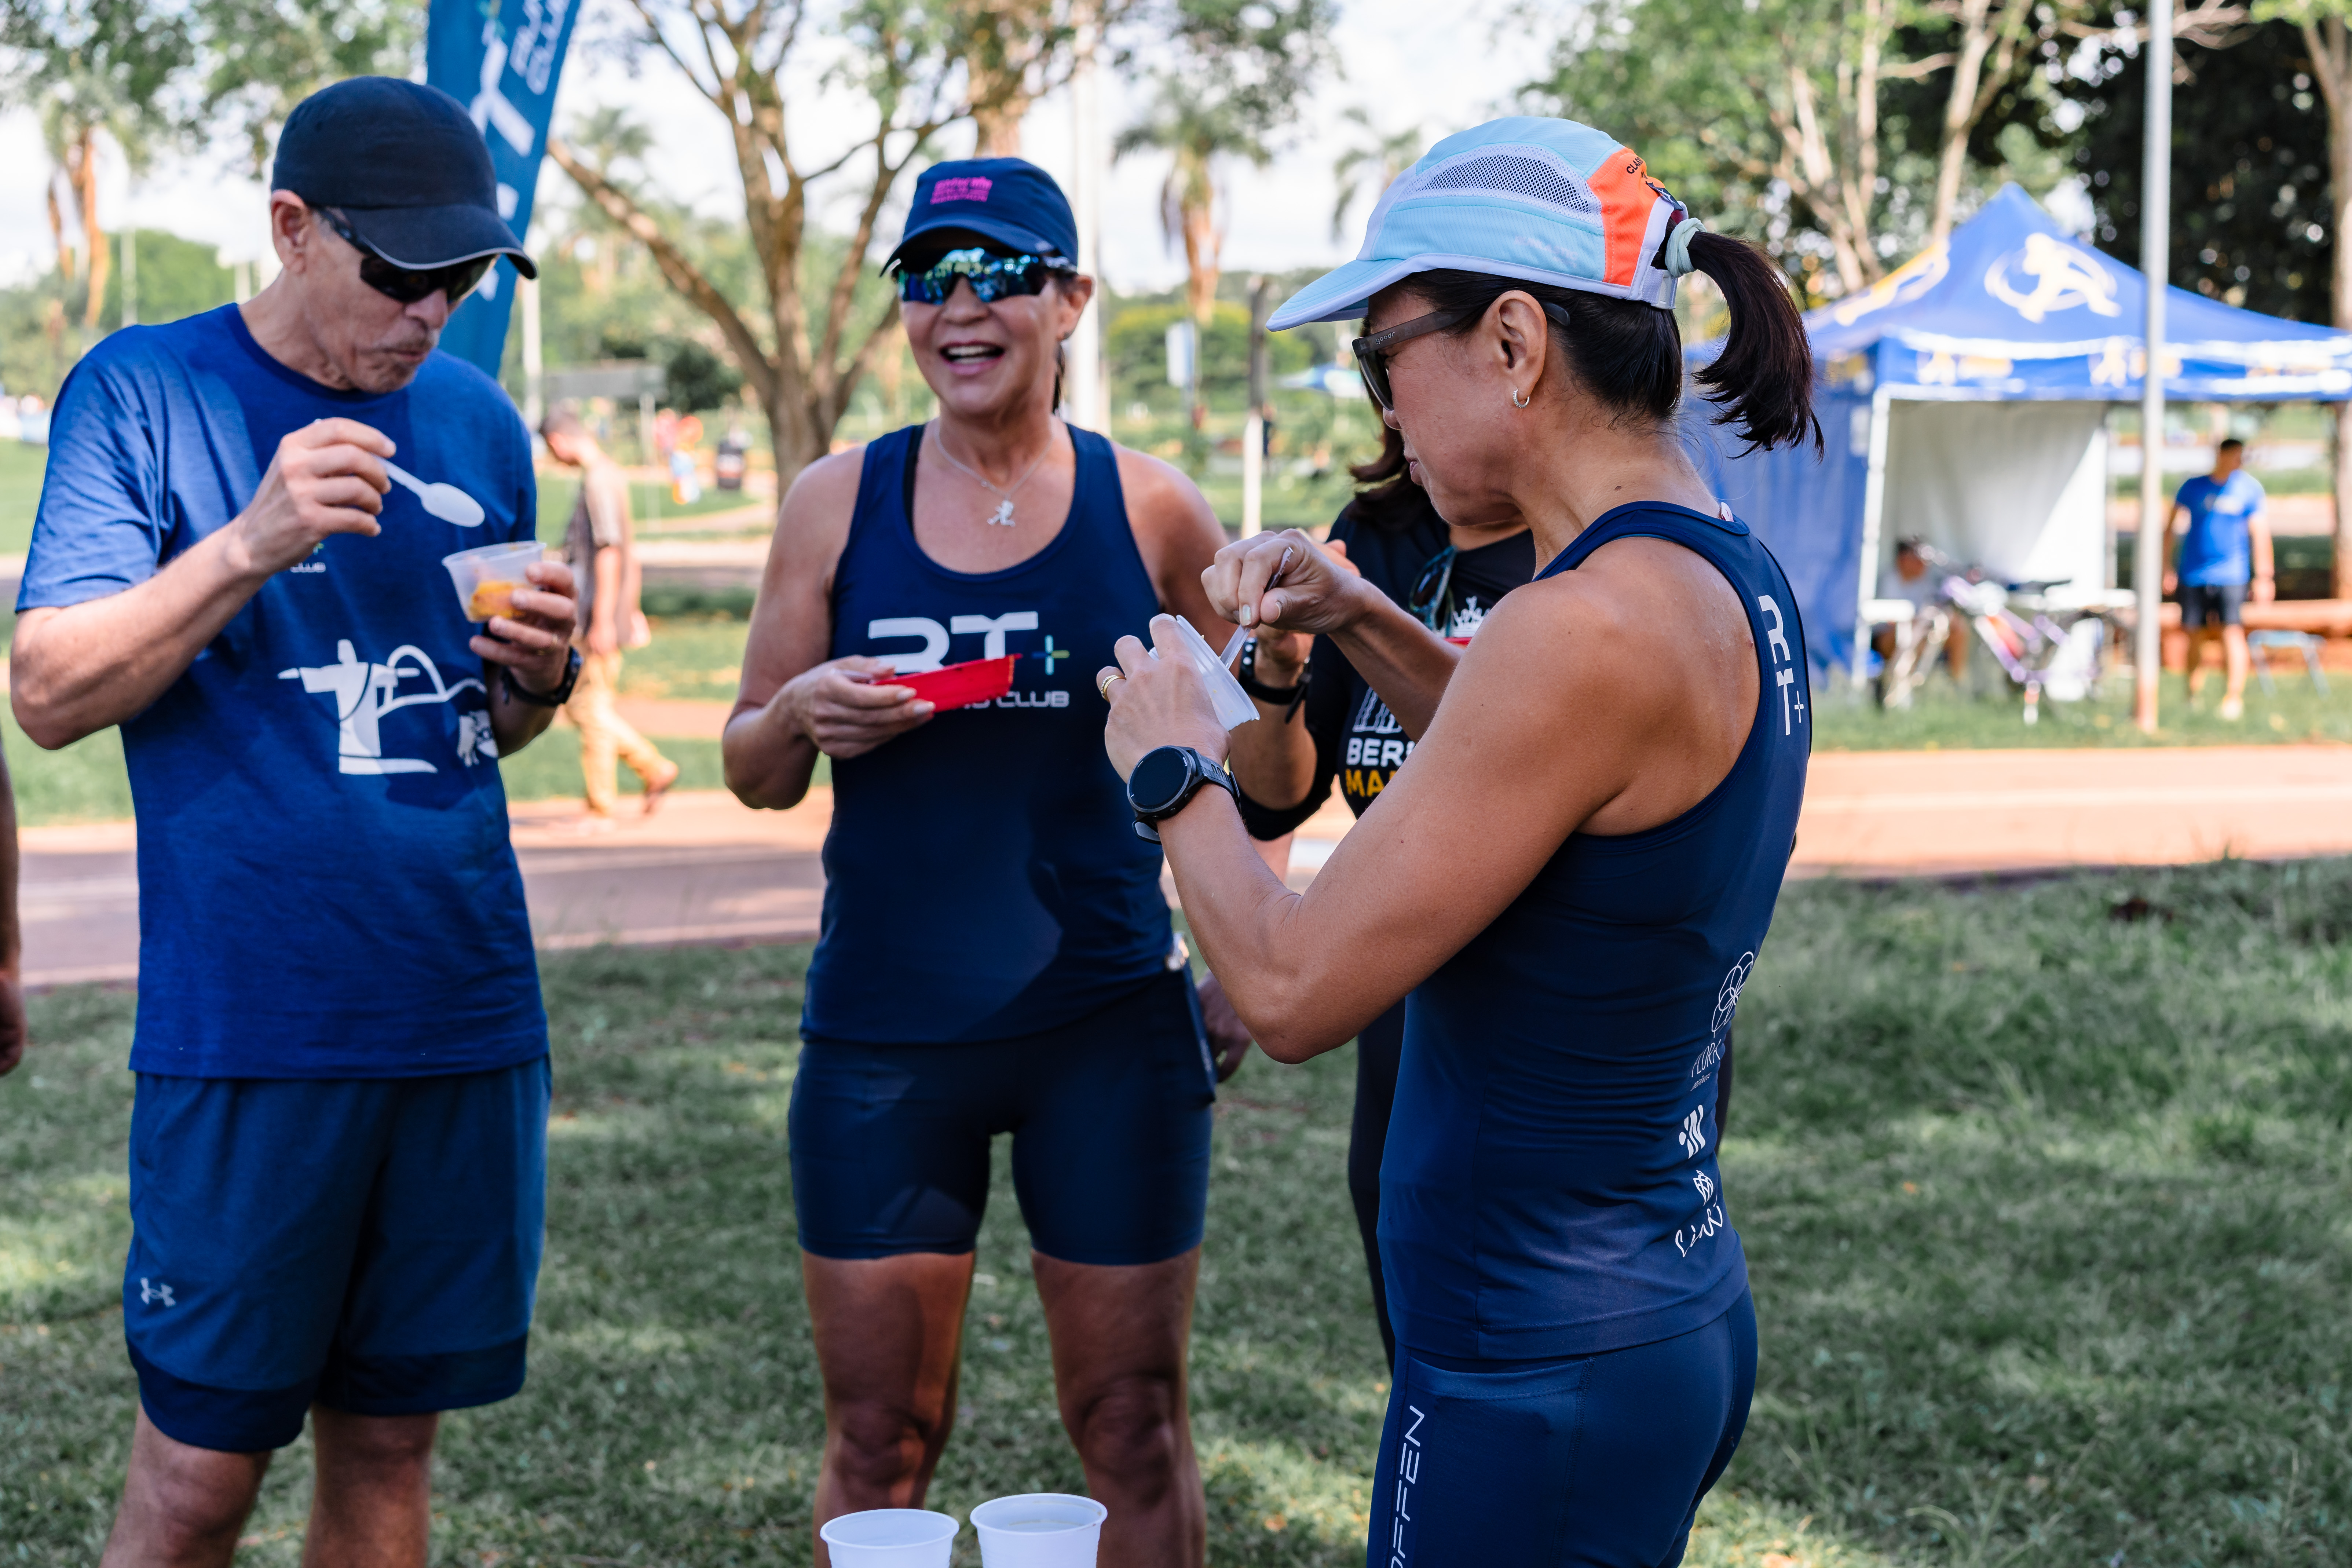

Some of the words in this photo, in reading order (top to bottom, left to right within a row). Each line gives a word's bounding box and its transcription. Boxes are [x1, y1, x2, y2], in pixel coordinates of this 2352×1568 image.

[1376, 332, 1395, 344] goodr
[996, 691, 1069, 708] CLUB
[1346, 769, 1397, 797] MA
